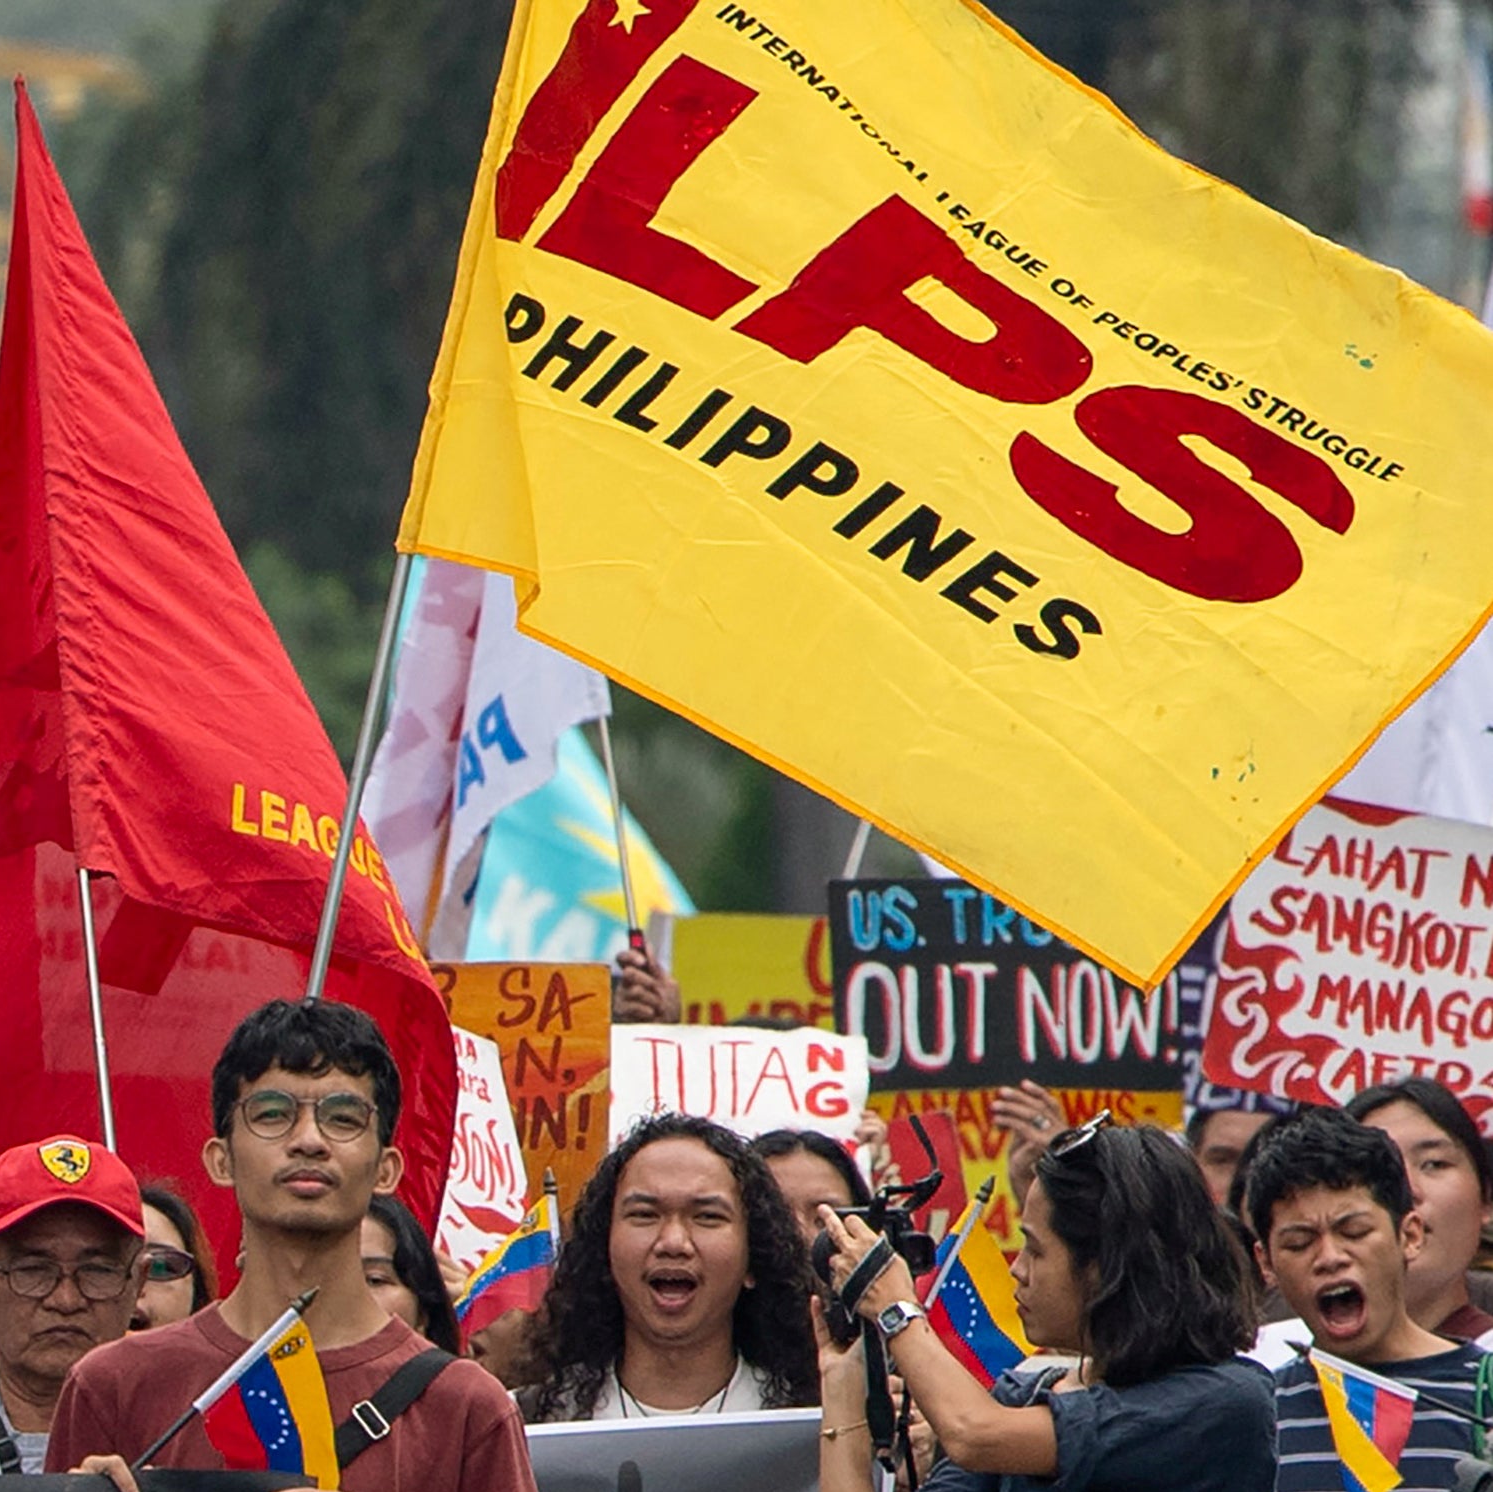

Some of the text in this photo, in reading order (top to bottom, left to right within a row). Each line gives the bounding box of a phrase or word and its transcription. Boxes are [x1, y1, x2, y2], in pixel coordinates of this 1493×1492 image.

[715, 3, 929, 187] INTERNATIONAL
[1049, 278, 1095, 313] OF
[1092, 310, 1244, 393] PEOPLES'
[1242, 387, 1405, 484] STRUGGLE
[495, 0, 1355, 603] ILPS
[503, 292, 1104, 661] PHILIPPINES
[232, 783, 390, 893] LEAGUE
[1272, 828, 1452, 900] LAHAT
[847, 886, 927, 951] US.
[846, 961, 999, 1073] OUT
[1018, 960, 1178, 1064] NOW!
